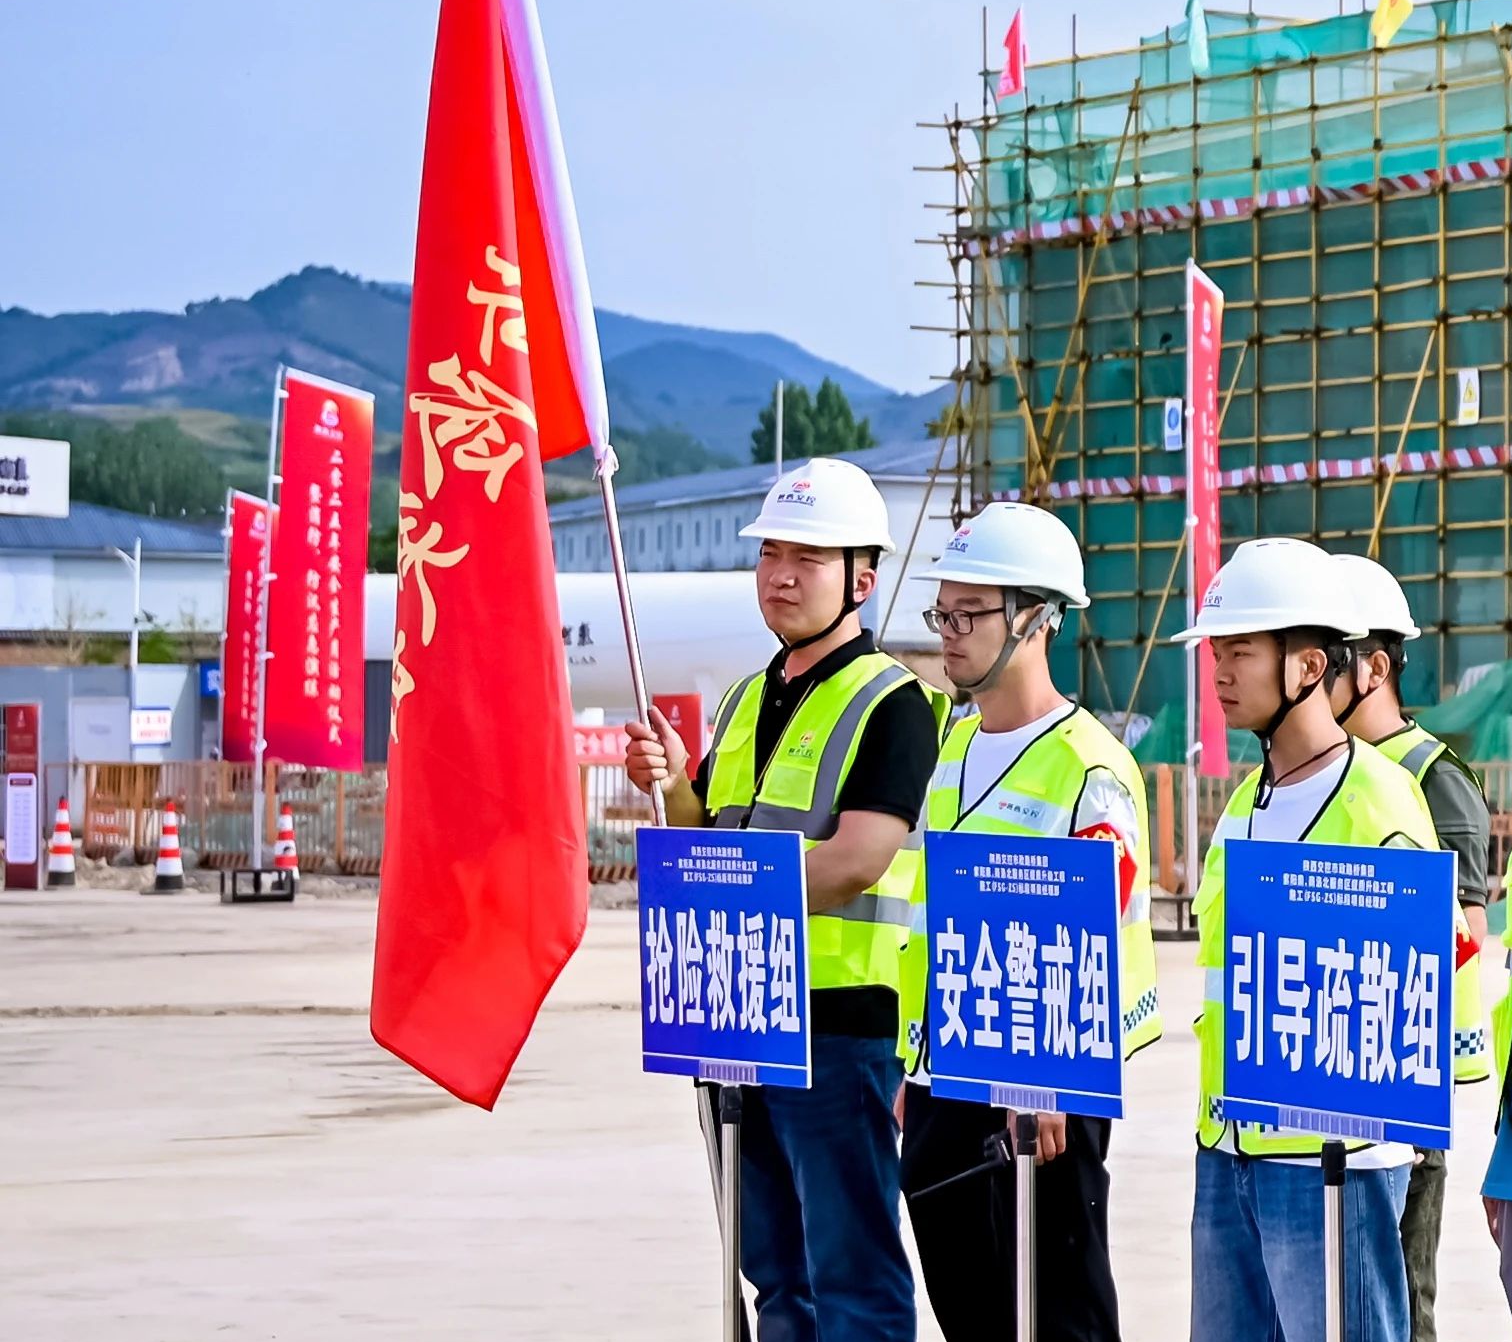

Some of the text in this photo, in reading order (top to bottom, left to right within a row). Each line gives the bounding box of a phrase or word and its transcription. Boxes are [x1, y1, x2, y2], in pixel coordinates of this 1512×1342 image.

[646, 906, 801, 1035] 抢险救援组
[936, 917, 1114, 1060] 安全警戒组
[1230, 931, 1443, 1087] 引导疏散组
